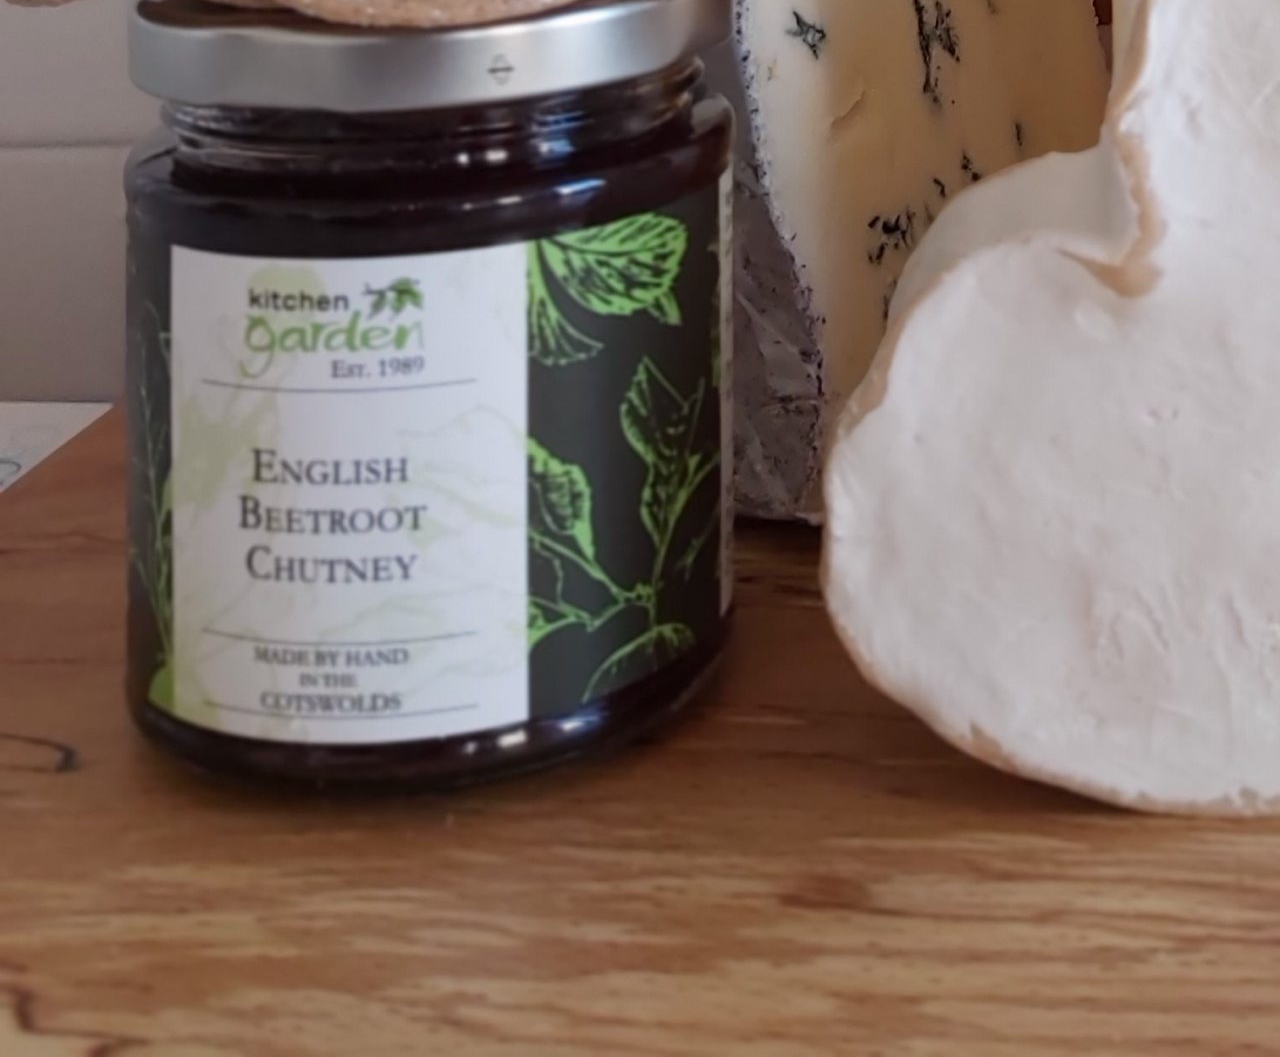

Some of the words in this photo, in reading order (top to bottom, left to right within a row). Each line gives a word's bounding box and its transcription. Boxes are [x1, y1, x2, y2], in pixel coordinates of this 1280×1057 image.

[249, 288, 349, 312] kitchen
[240, 310, 424, 378] garden
[378, 356, 425, 377] 1989
[251, 448, 409, 485] ENGLISH
[239, 495, 427, 534] BEETROOT
[245, 546, 417, 584] CHUTNEY
[254, 646, 309, 666] MADE
[314, 650, 339, 666] BY
[345, 648, 409, 667] HAND
[322, 673, 357, 687] THE
[260, 692, 402, 712] COTSWOLDS
